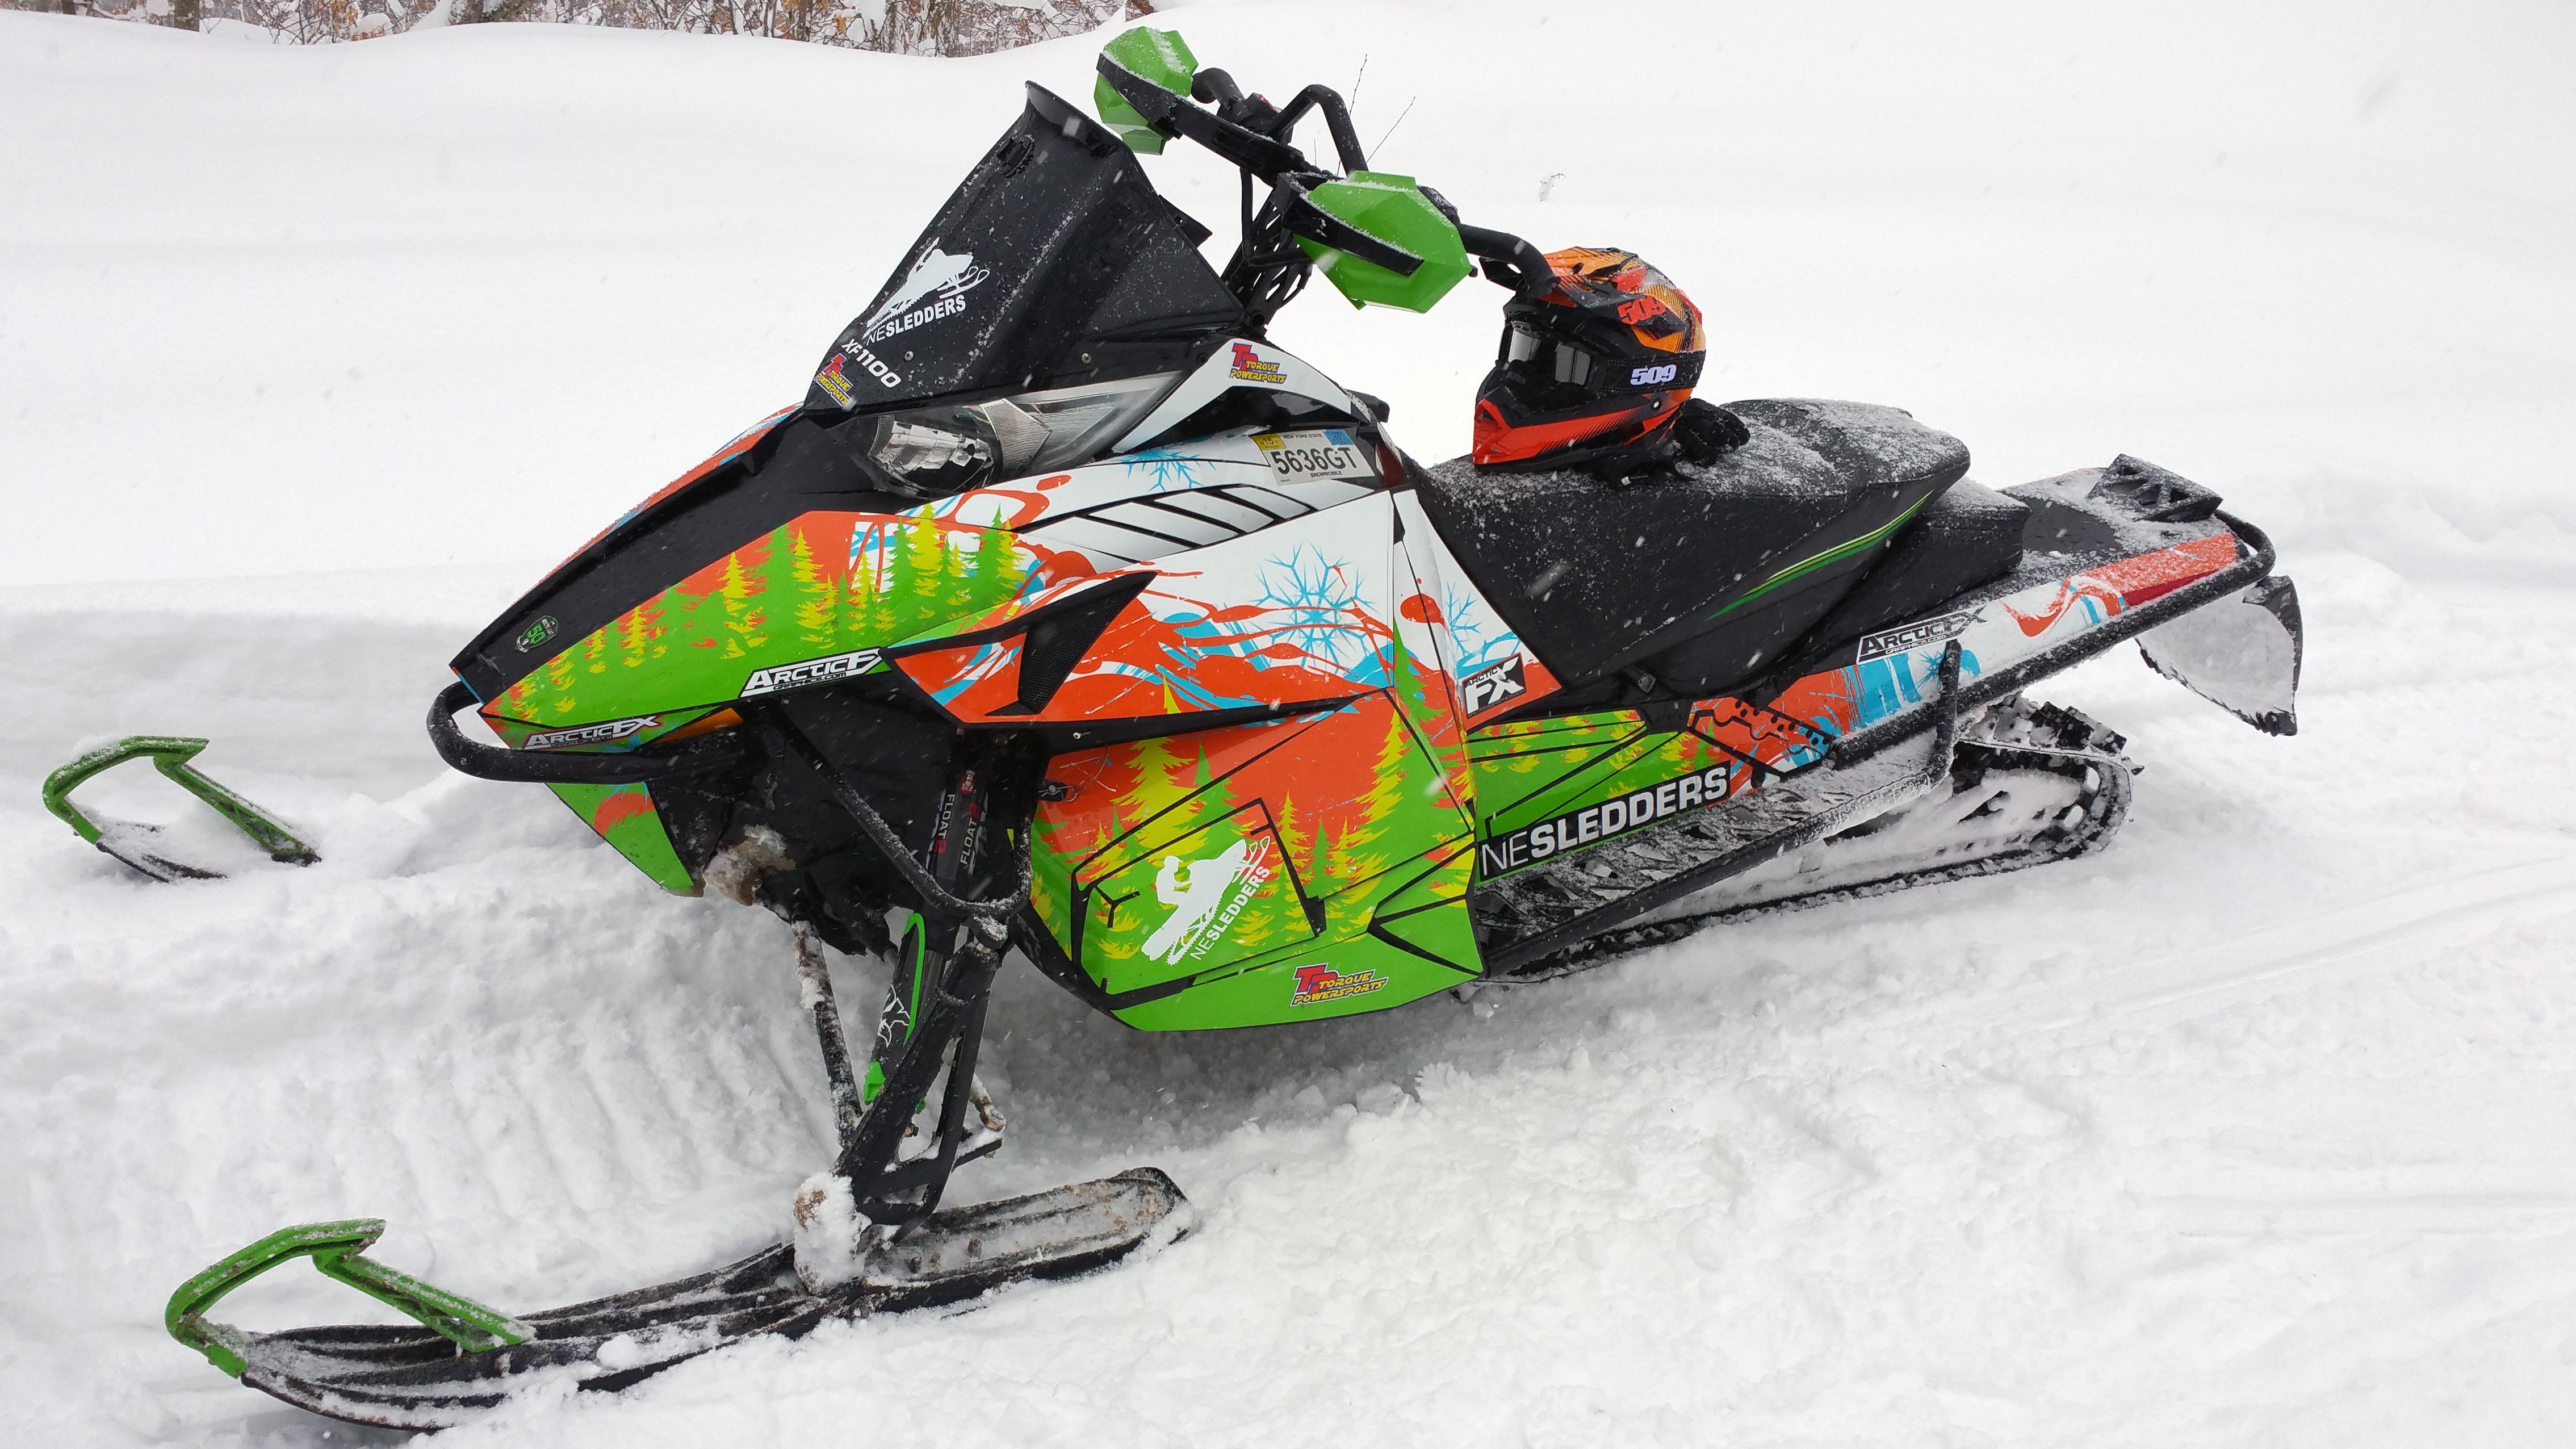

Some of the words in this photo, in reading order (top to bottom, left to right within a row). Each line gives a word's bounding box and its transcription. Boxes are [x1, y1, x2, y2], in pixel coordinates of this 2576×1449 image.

[866, 294, 966, 346] NESLEDDERS
[1618, 295, 1666, 325] 509
[841, 338, 902, 388] XF1100
[1246, 361, 1279, 371] TORQUE
[828, 370, 851, 391] TORQUE
[1231, 369, 1286, 383] POWERSPORTS
[1630, 365, 1677, 386] 509
[816, 372, 849, 405] POWERSPORTS
[1270, 447, 1358, 475] 5636GT
[527, 624, 546, 644] 50
[1886, 634, 1946, 655] GRAPHICS.COM
[773, 672, 847, 691] GRAPHICS.COM
[1465, 668, 1498, 687] ARCTIC
[522, 715, 660, 747] ARCTICFX
[1481, 767, 1728, 876] NESLEDDERS
[1189, 866, 1270, 961] NESLEDDERS
[1293, 979, 1385, 1004] POWERSPORTS
[1319, 972, 1372, 990] TORQUE
